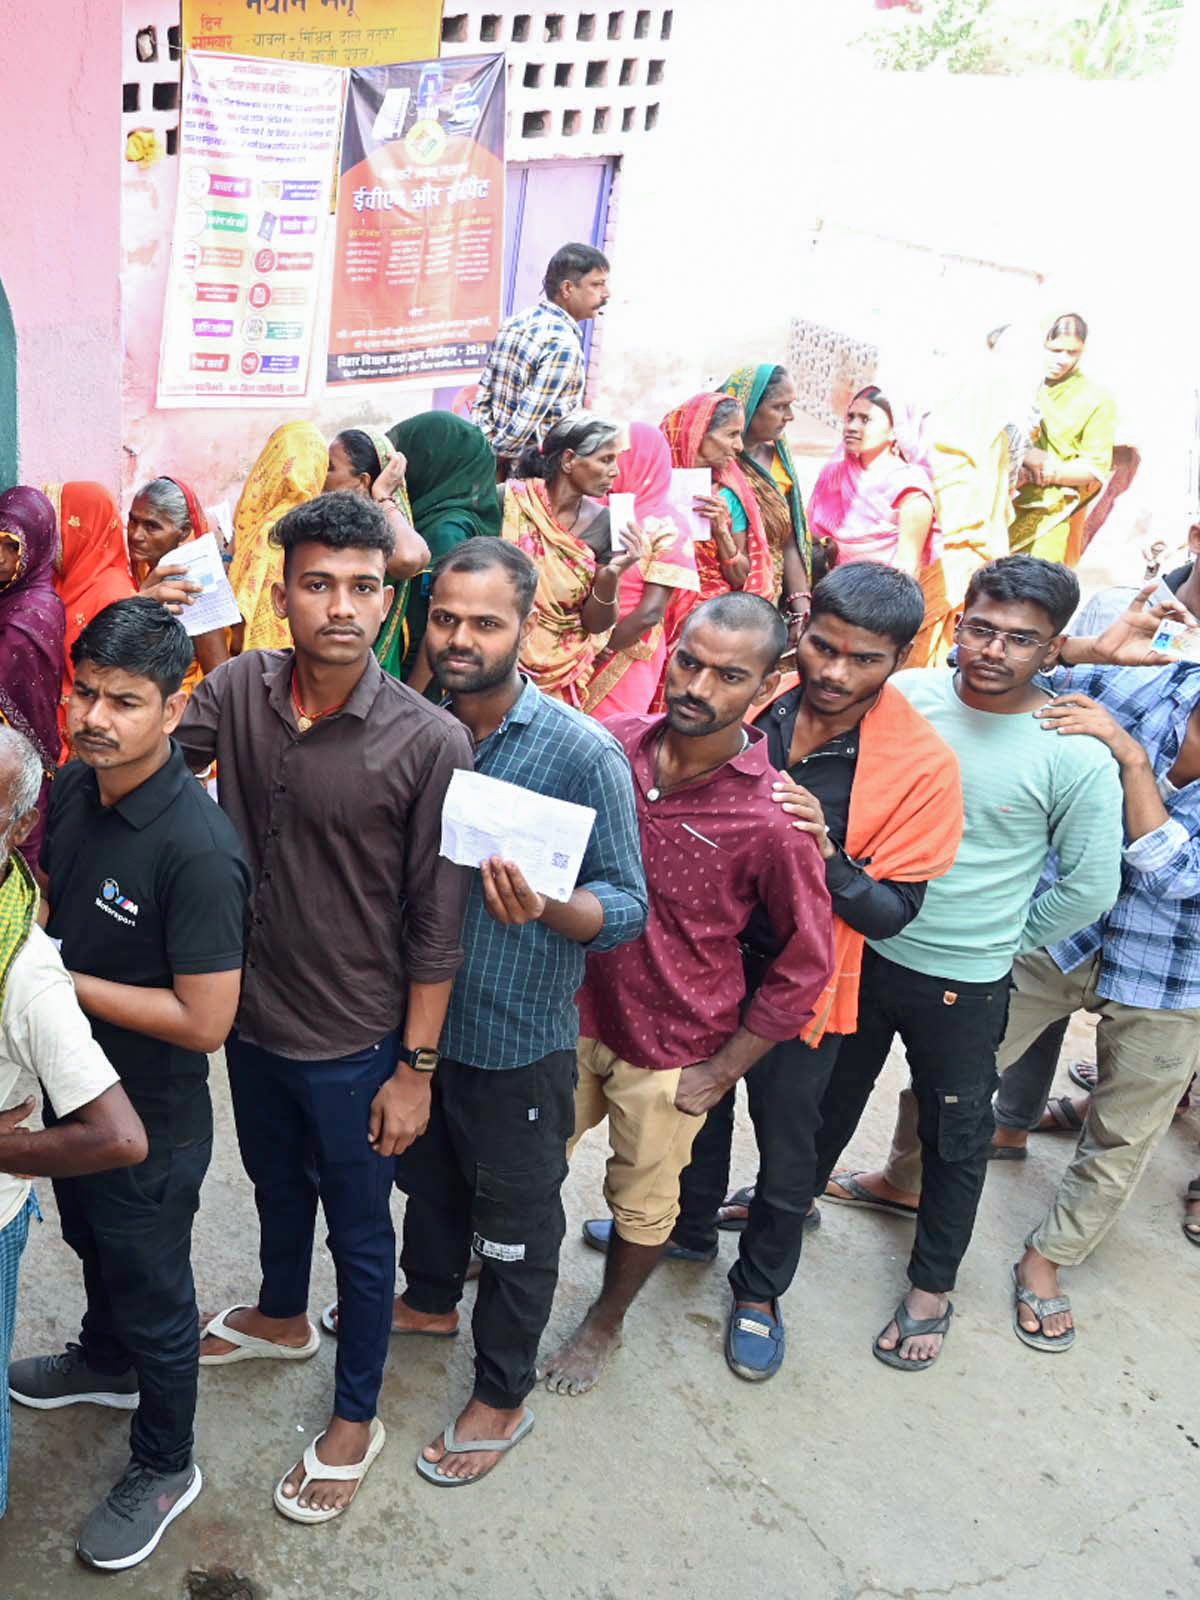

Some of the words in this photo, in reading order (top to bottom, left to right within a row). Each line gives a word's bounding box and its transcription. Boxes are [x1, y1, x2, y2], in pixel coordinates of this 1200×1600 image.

[200, 13, 223, 31] दिन
[191, 31, 233, 49] सोमवार
[411, 181, 442, 210] और
[94, 897, 137, 927] Motorsport
